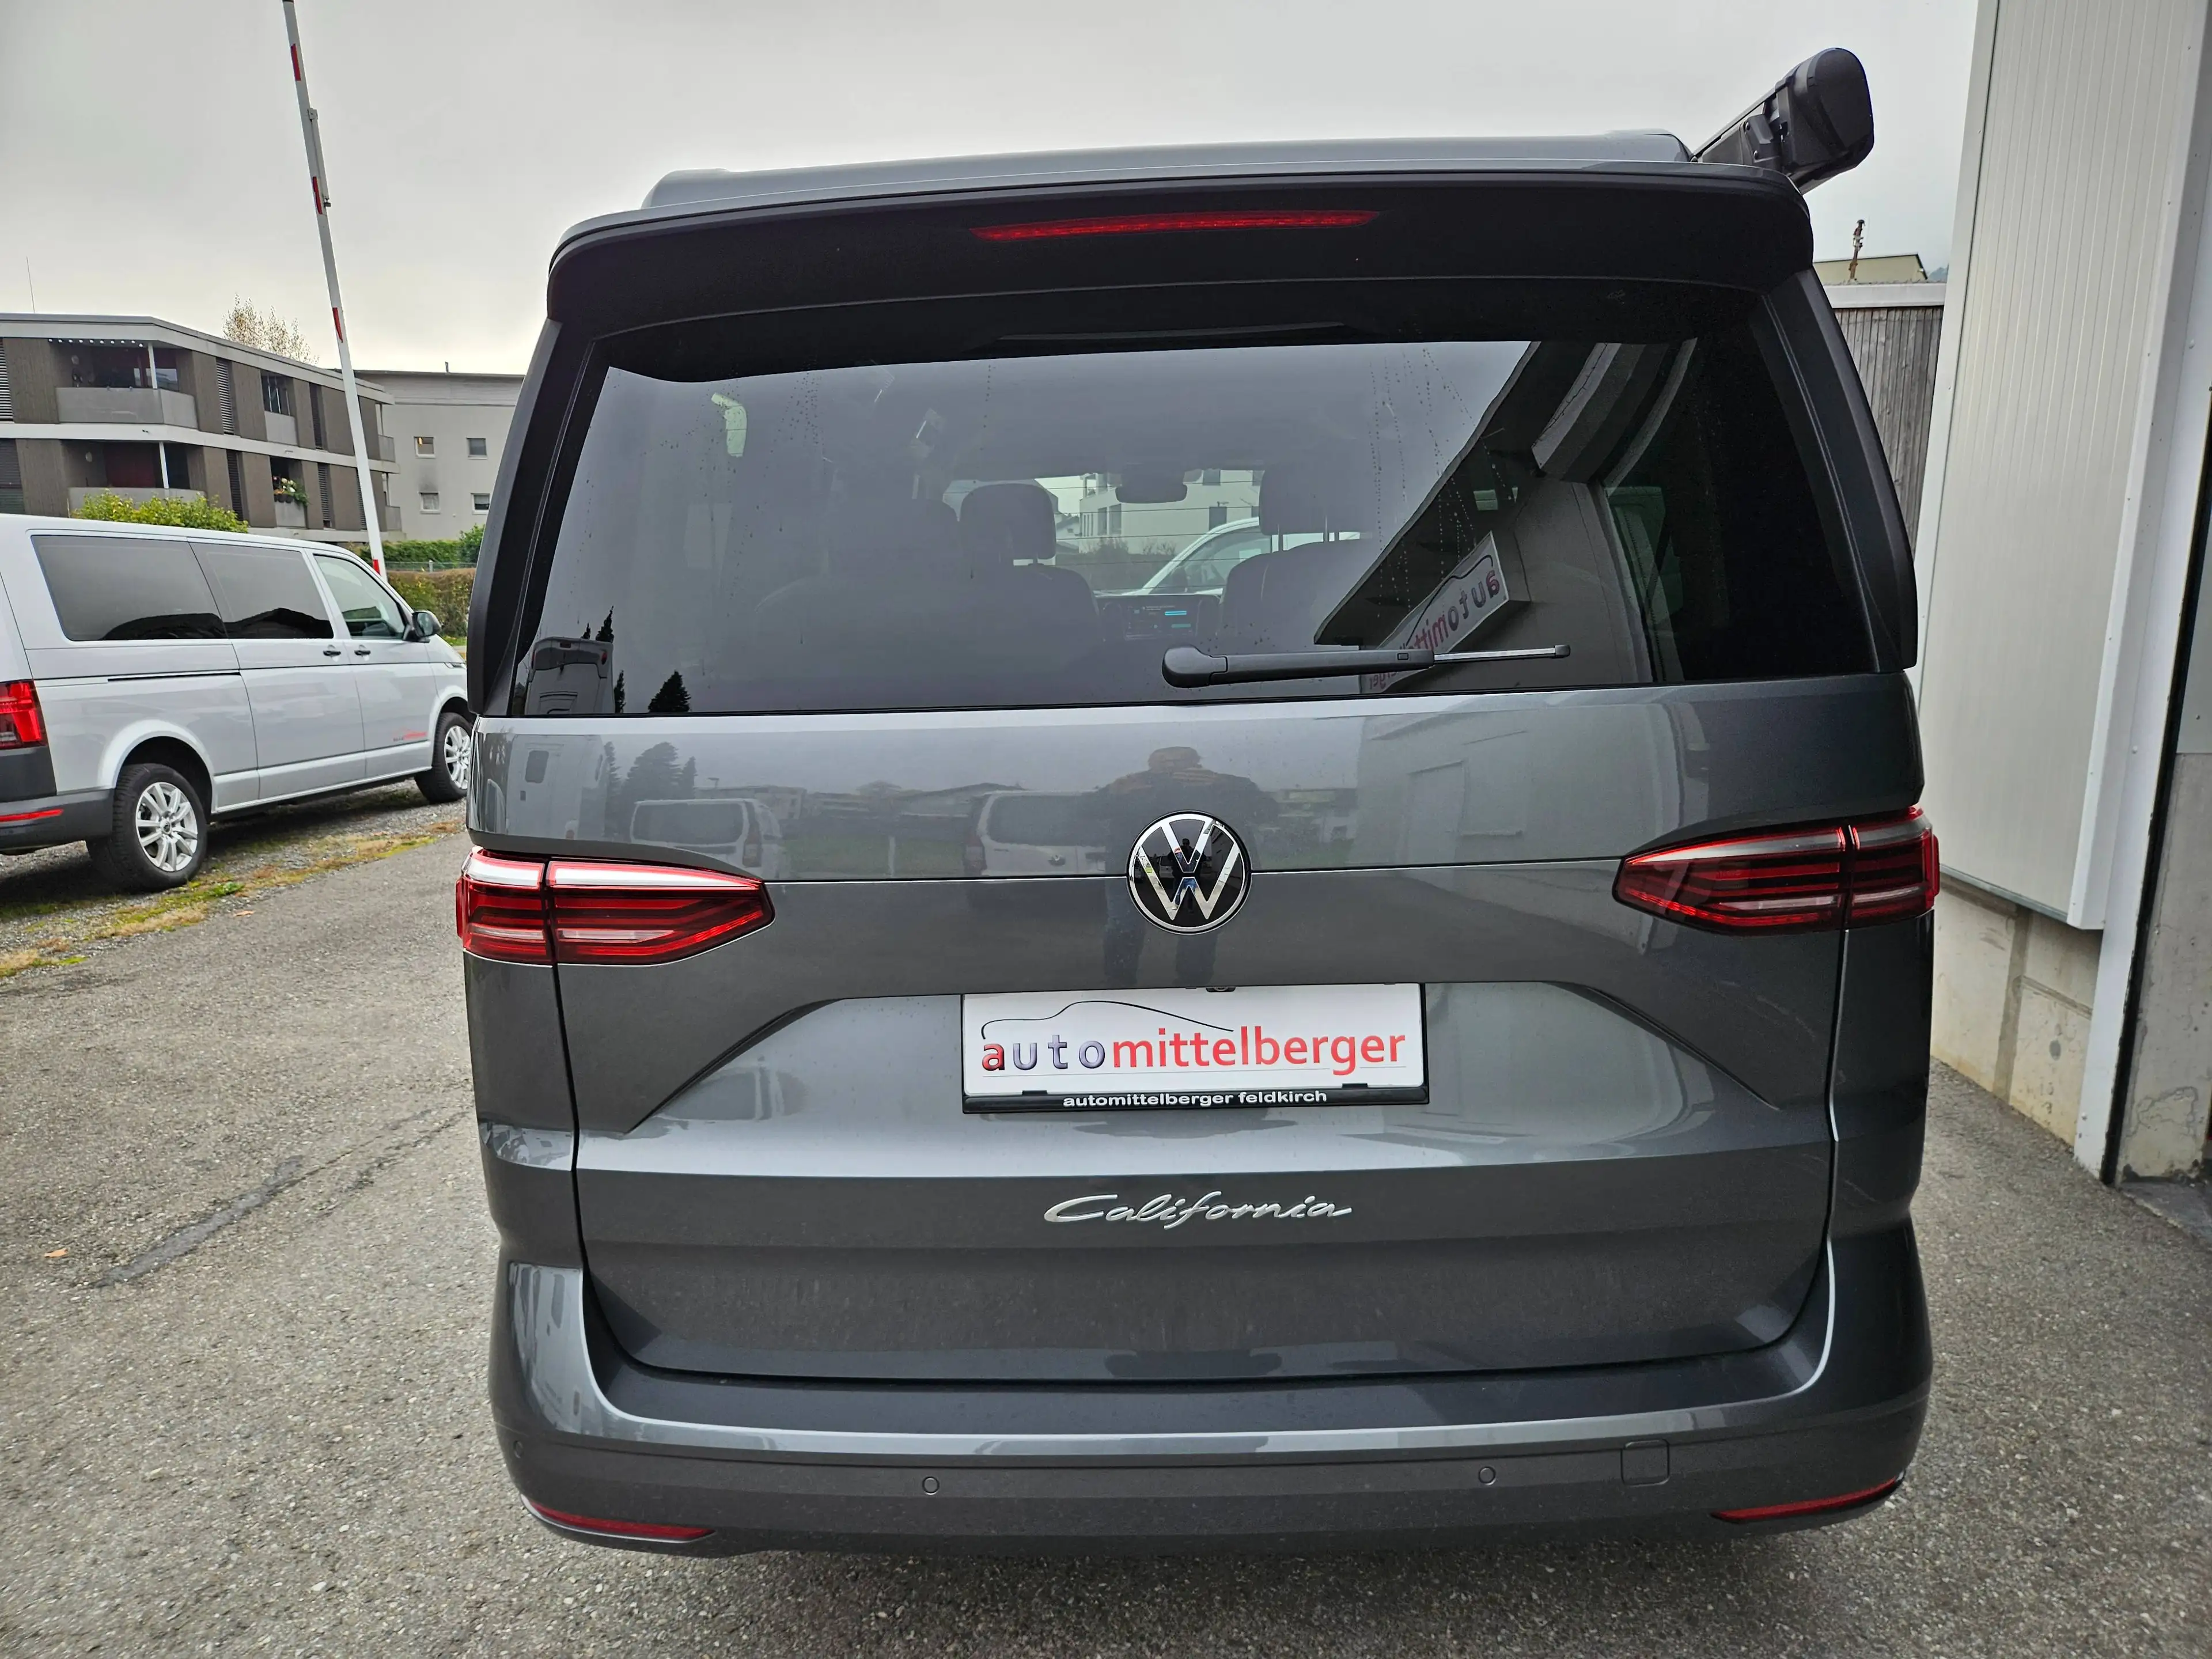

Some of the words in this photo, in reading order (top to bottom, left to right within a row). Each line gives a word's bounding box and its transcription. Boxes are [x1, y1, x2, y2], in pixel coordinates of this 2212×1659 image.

[981, 1025, 1406, 1075] automittelberger
[1062, 1093, 1234, 1108] automittelberger
[1238, 1090, 1328, 1104] feldkirch
[1043, 1191, 1353, 1230] California
